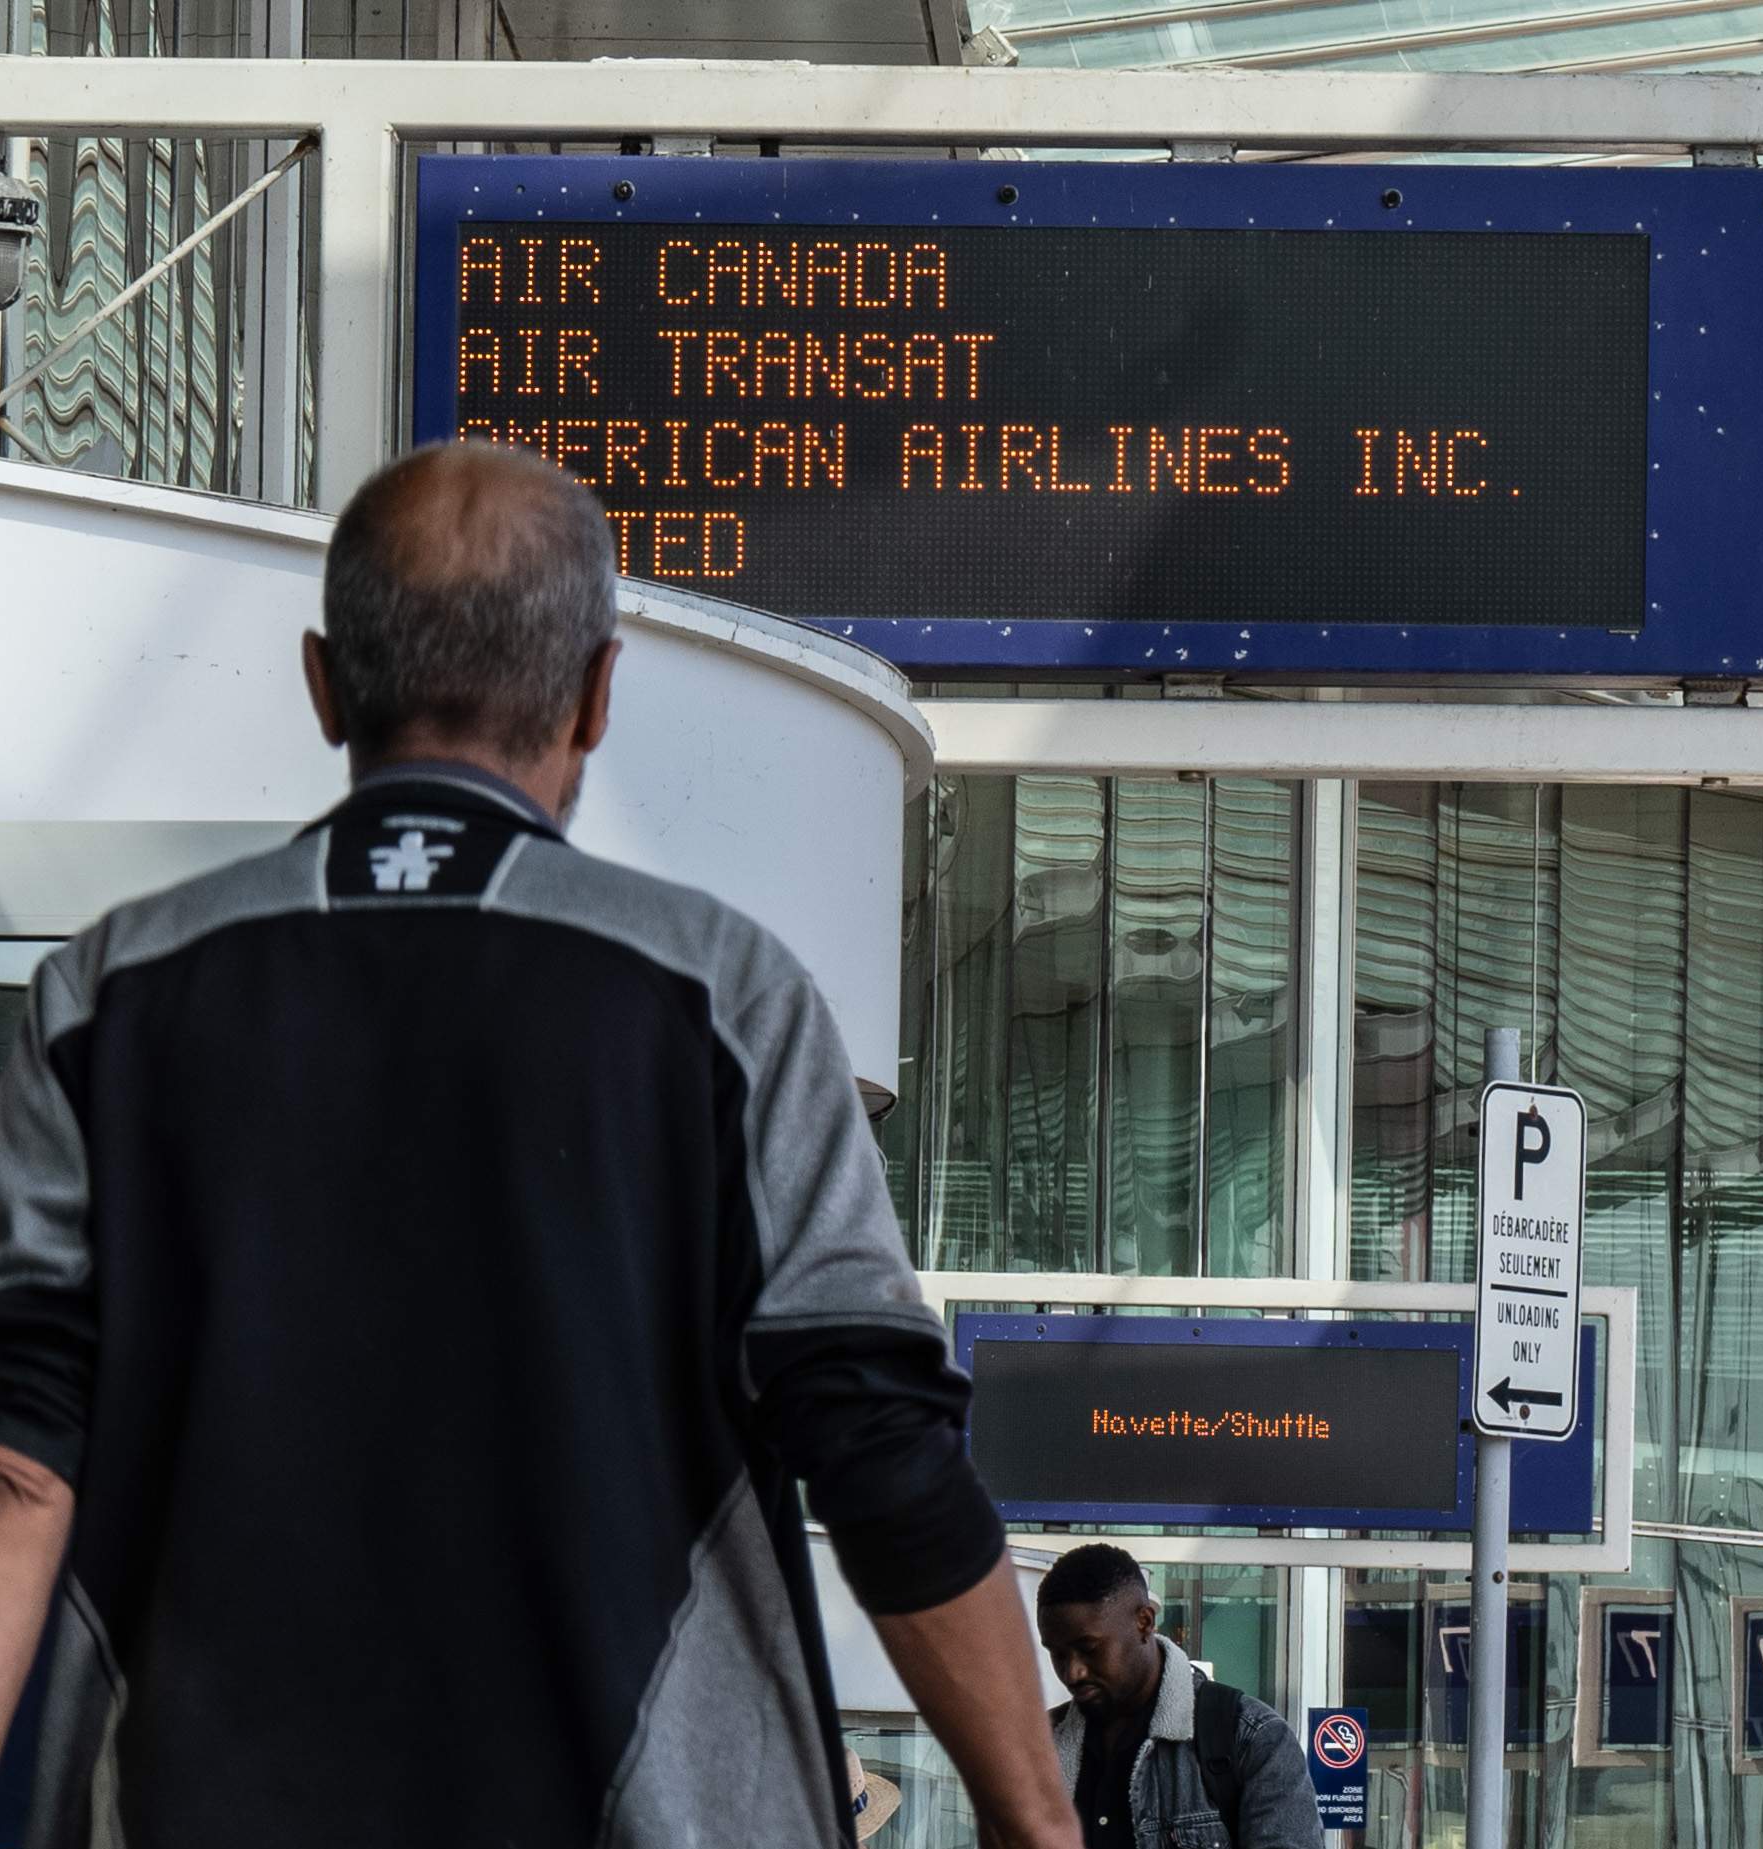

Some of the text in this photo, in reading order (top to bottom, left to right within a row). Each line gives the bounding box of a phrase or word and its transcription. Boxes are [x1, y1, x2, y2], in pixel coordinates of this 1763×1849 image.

[459, 238, 947, 309] AIR CANADA
[456, 327, 996, 400] AIR TRANSAT
[902, 423, 1293, 496] AIRLINES
[1353, 427, 1524, 498] INC.
[604, 510, 746, 578] TED
[1513, 1111, 1552, 1201] P
[1492, 1211, 1570, 1244] DÉBARCADÈRE
[1498, 1252, 1561, 1280] SEULEMENT
[1497, 1301, 1560, 1330] UNLOADING
[1512, 1339, 1541, 1364] ONLY
